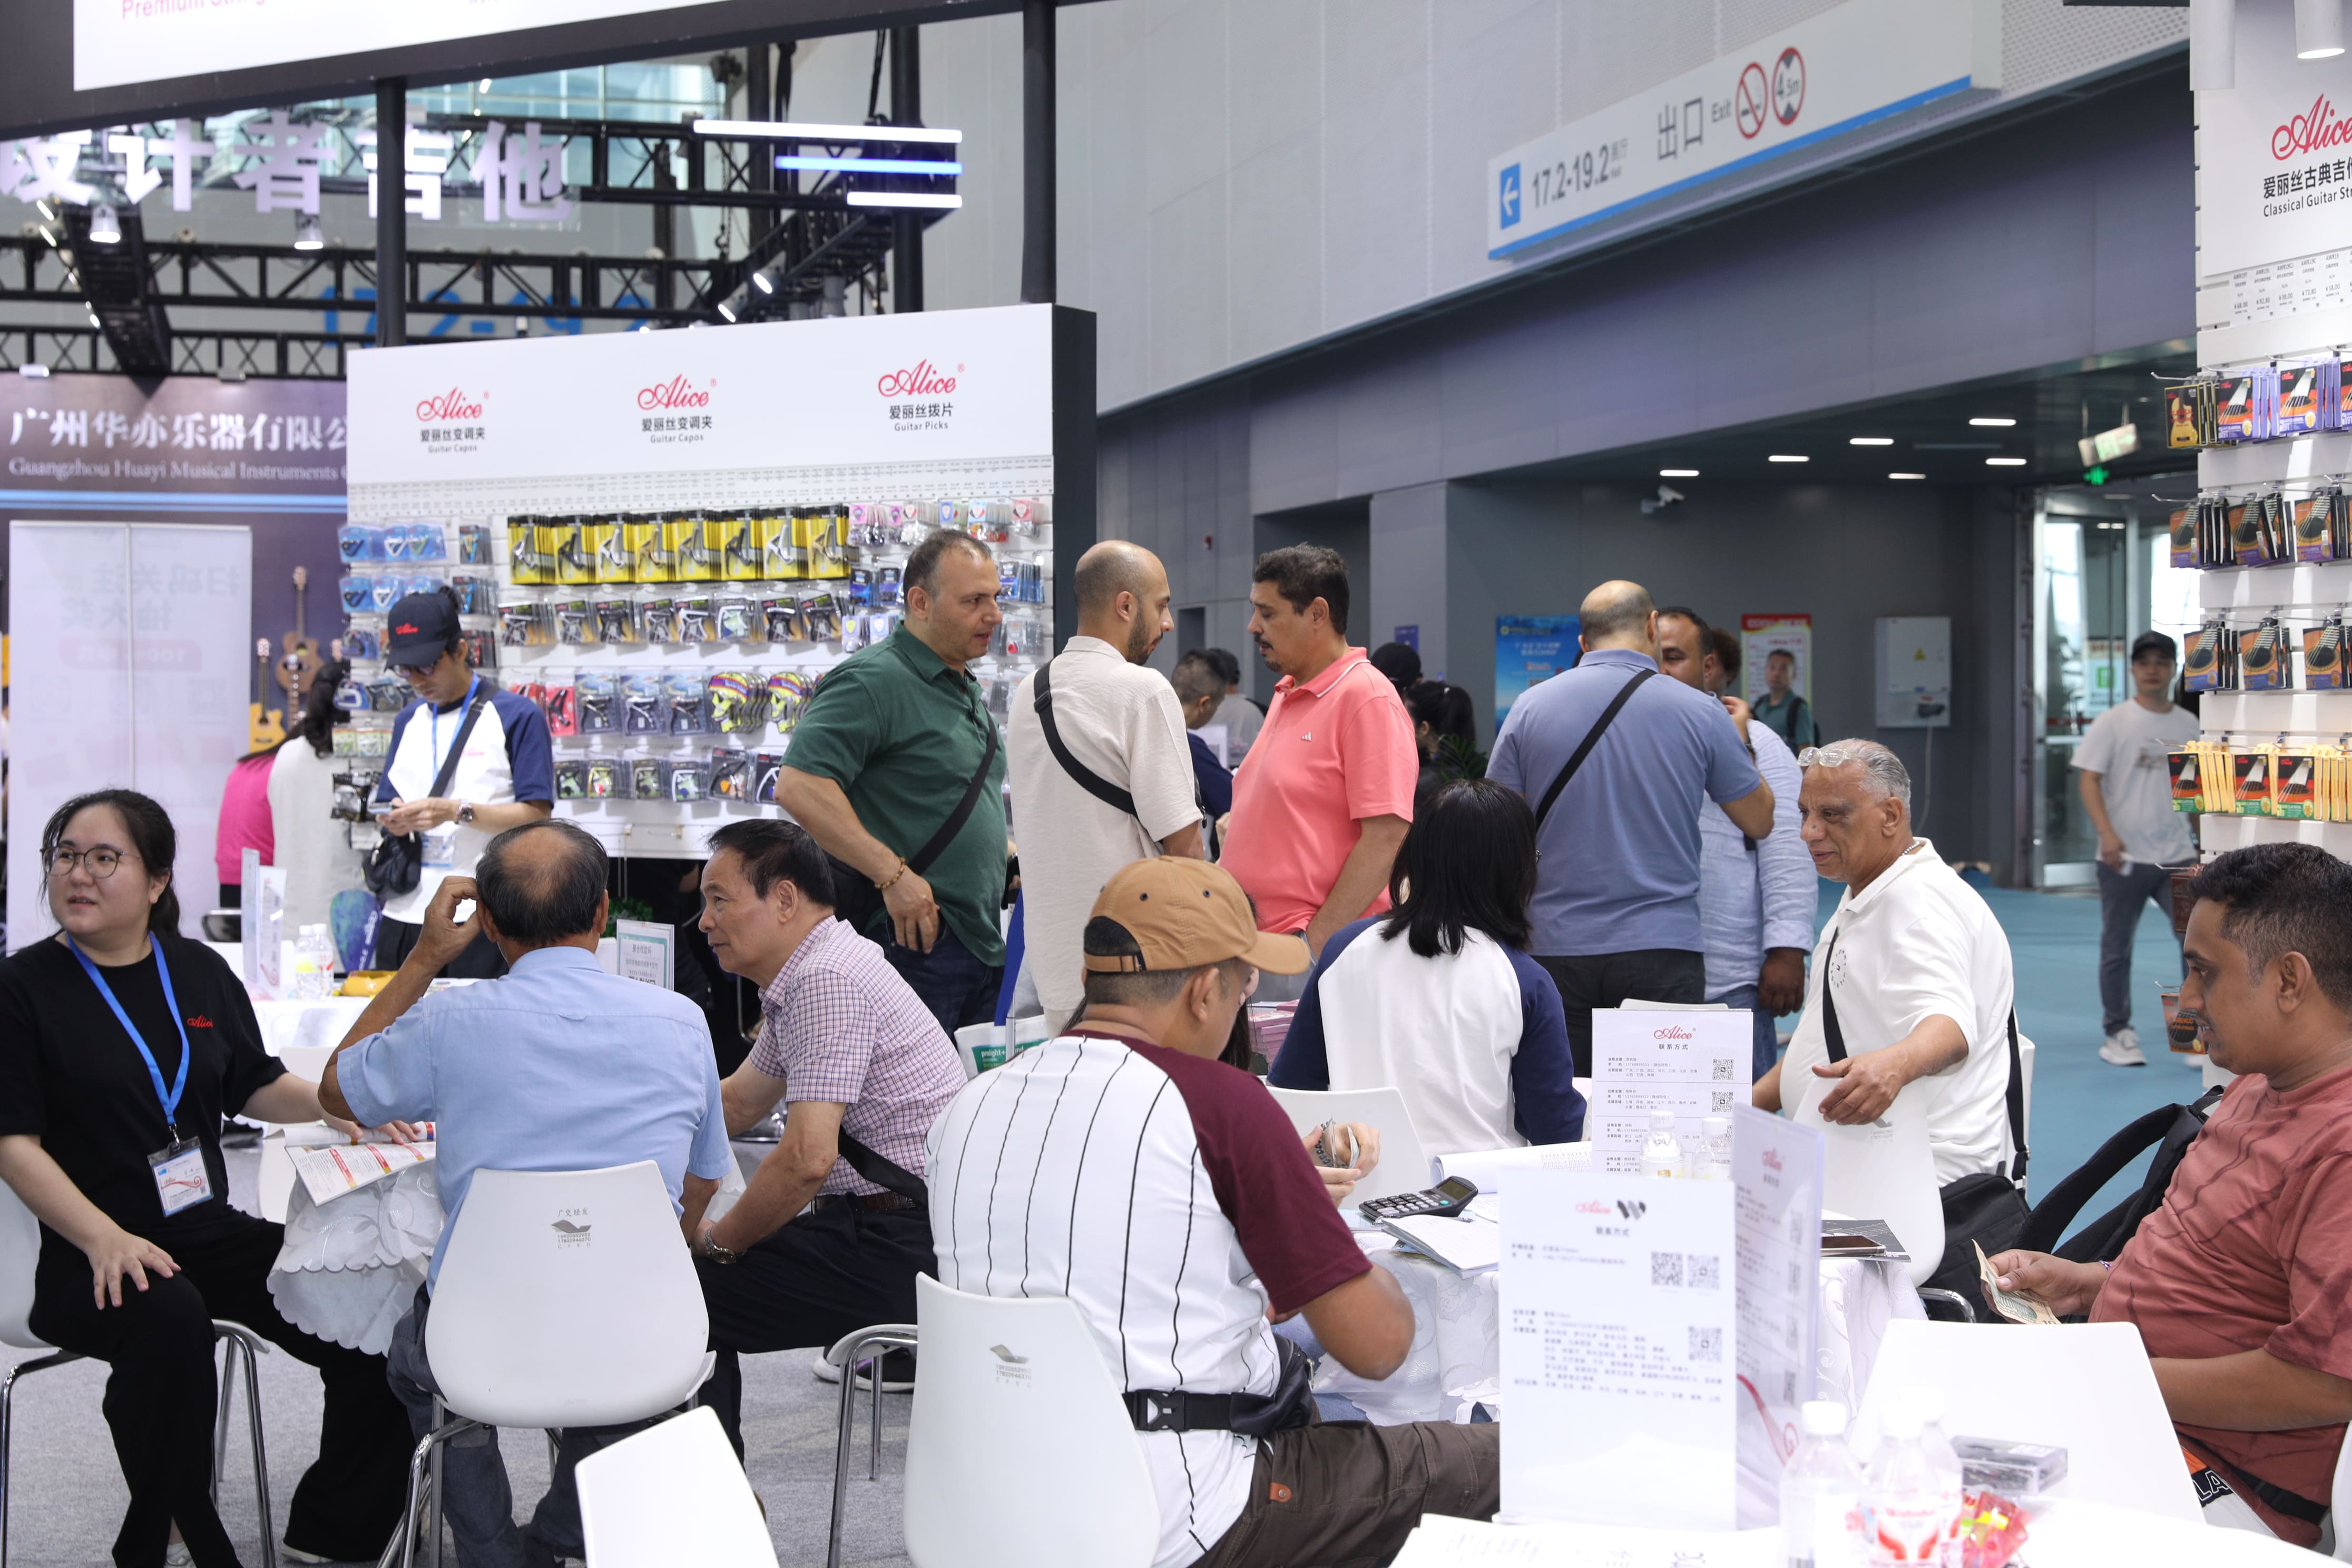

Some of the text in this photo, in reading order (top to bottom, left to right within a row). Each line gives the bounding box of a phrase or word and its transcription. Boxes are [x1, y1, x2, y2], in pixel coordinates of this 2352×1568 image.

[2271, 93, 2352, 161] Alice
[1532, 144, 1609, 208] 17.2-19.2
[1658, 96, 1703, 162] 出口
[2263, 195, 2304, 217] Classical
[2307, 191, 2337, 207] Guitar
[878, 359, 956, 397] Alice
[417, 386, 483, 422] Alice
[638, 374, 709, 410] Alice
[642, 415, 712, 432] 爱丽丝变调夹
[889, 402, 953, 419] 爱丽丝拨片
[421, 426, 485, 443] 爱丽丝变调夹
[650, 433, 704, 444] Guitar Capos
[894, 420, 948, 432] Guitar Picks
[8, 456, 110, 482] Guangzhou
[114, 459, 166, 483] Huayi
[170, 459, 236, 480] Musical
[240, 461, 339, 481] Instruments
[1653, 1025, 1692, 1040] Alice
